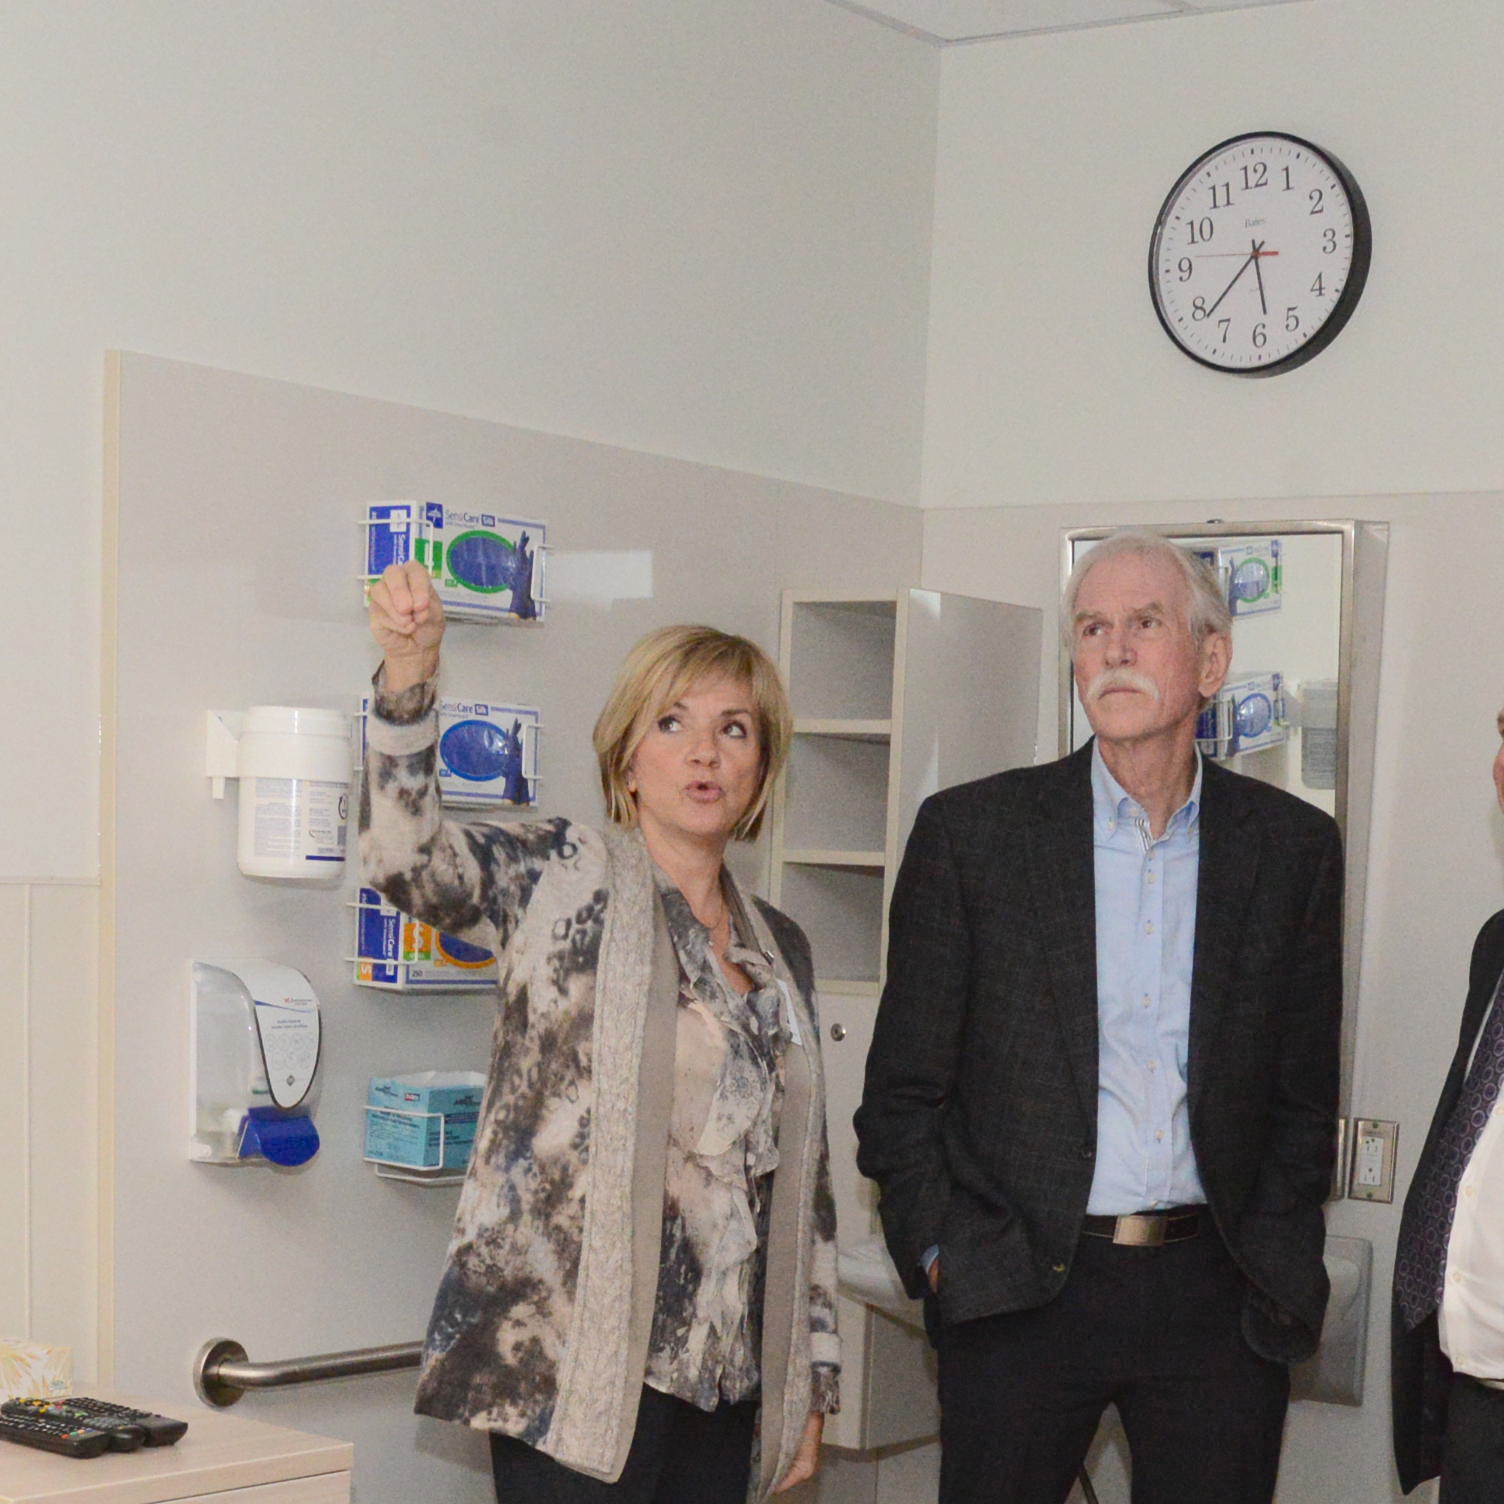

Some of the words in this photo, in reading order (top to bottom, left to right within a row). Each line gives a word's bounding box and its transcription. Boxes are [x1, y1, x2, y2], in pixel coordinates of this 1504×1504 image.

[1239, 162, 1269, 191] 12
[1281, 165, 1295, 191] 1
[1208, 182, 1235, 209] 11
[1308, 188, 1325, 215] 2
[1185, 216, 1214, 245] 10
[1322, 228, 1337, 254] 3
[1178, 257, 1193, 282] 9
[1310, 272, 1326, 297] 4
[1191, 296, 1207, 321] 8
[1285, 306, 1300, 332] 5
[1217, 318, 1231, 343] 7
[1252, 322, 1267, 348] 6
